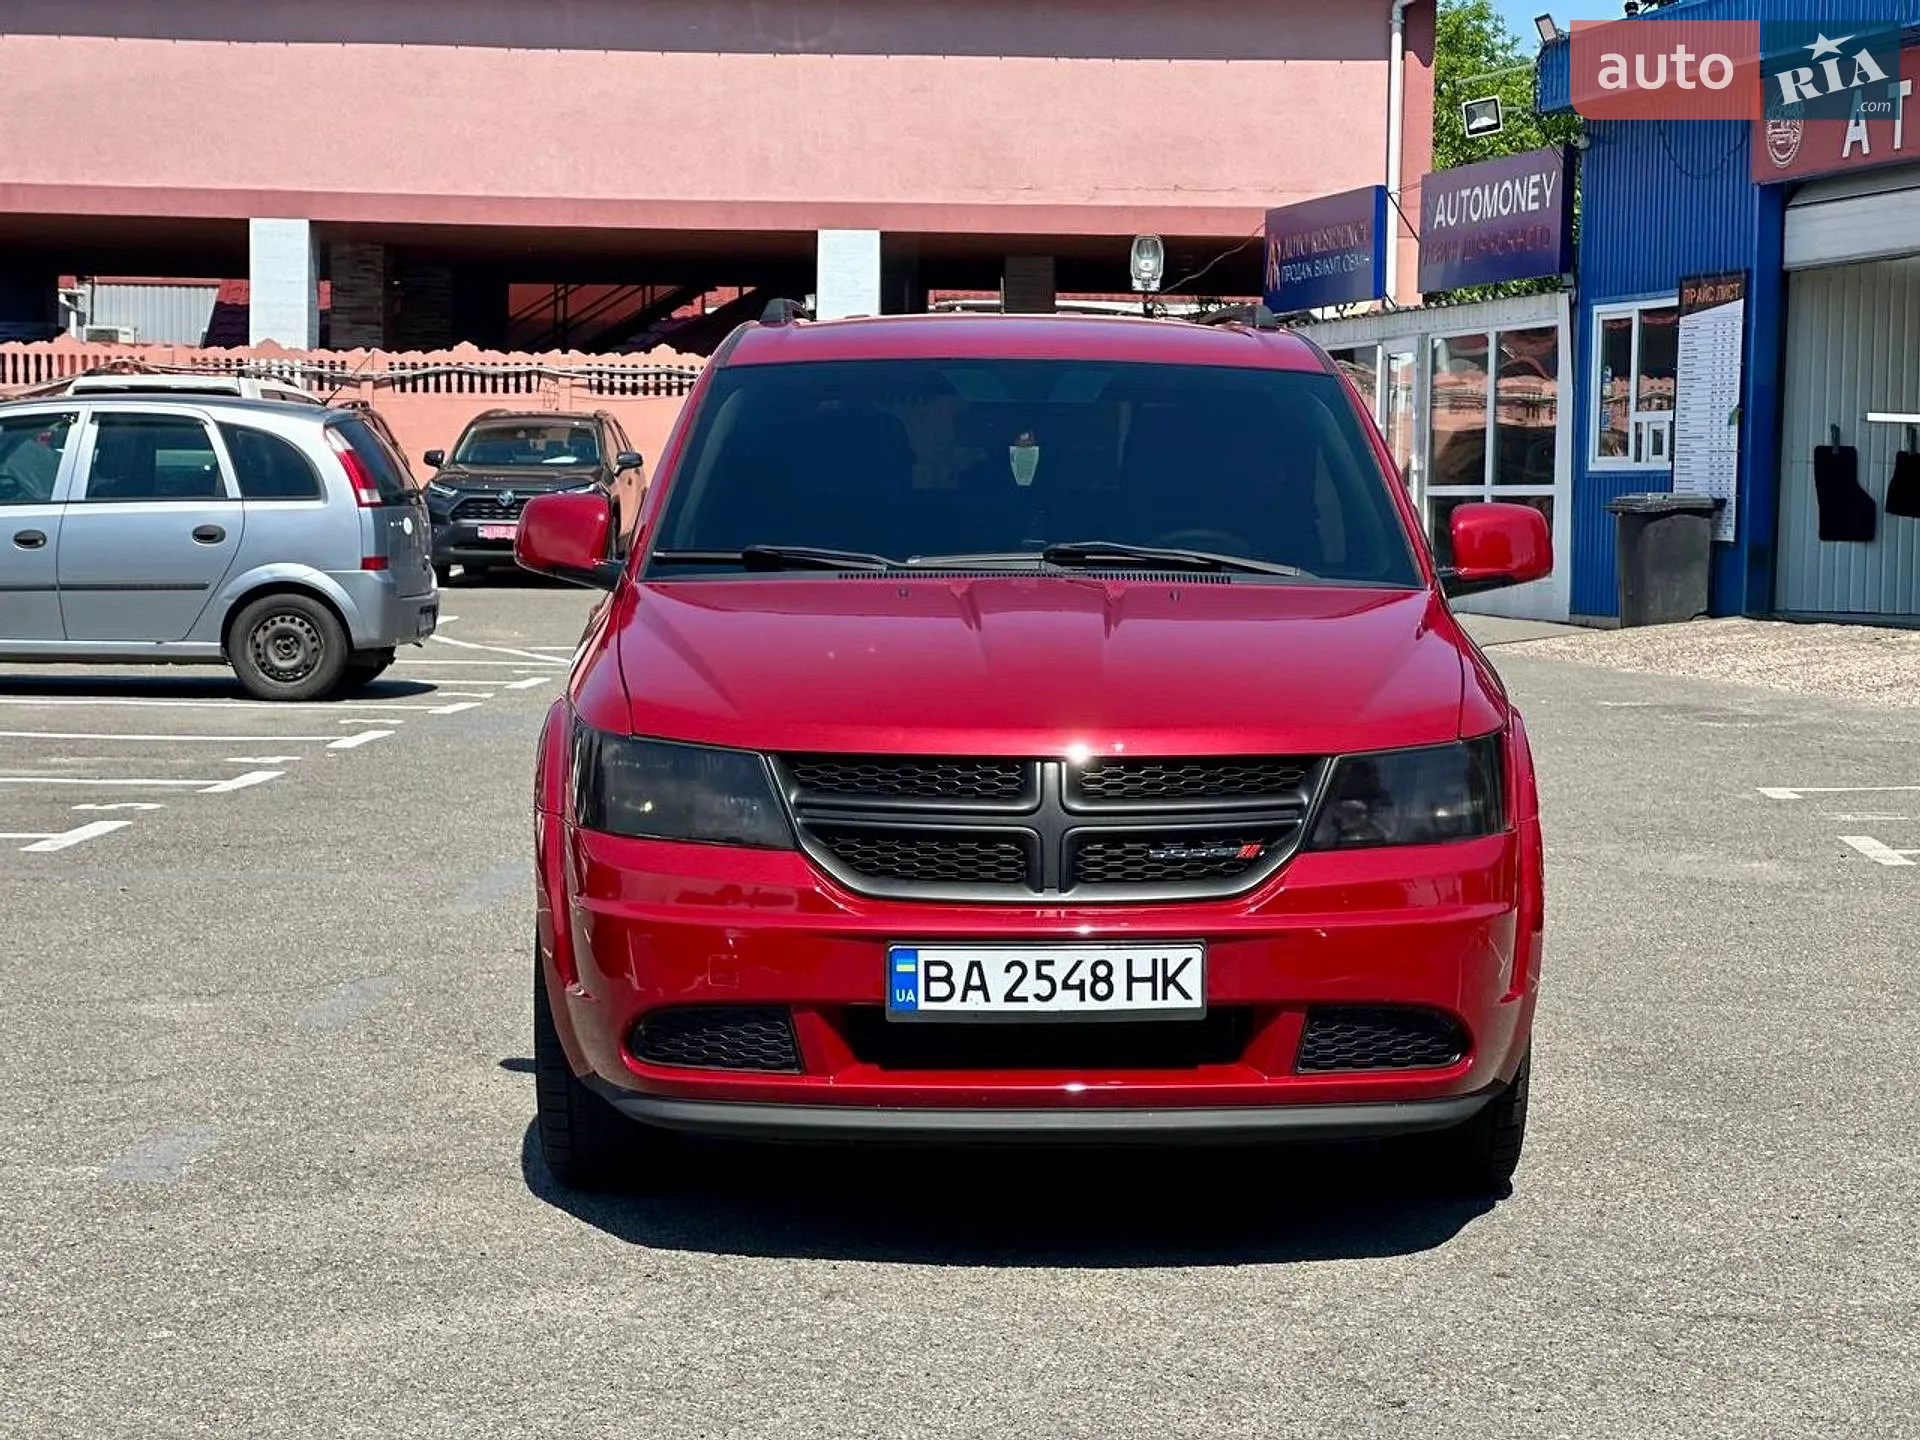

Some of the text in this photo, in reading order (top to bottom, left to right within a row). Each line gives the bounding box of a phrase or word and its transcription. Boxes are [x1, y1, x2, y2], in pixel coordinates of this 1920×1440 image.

[1433, 171, 1557, 229] AUTOMONEY
[896, 989, 916, 1003] UA
[923, 957, 1194, 1003] BA 2548 HK
